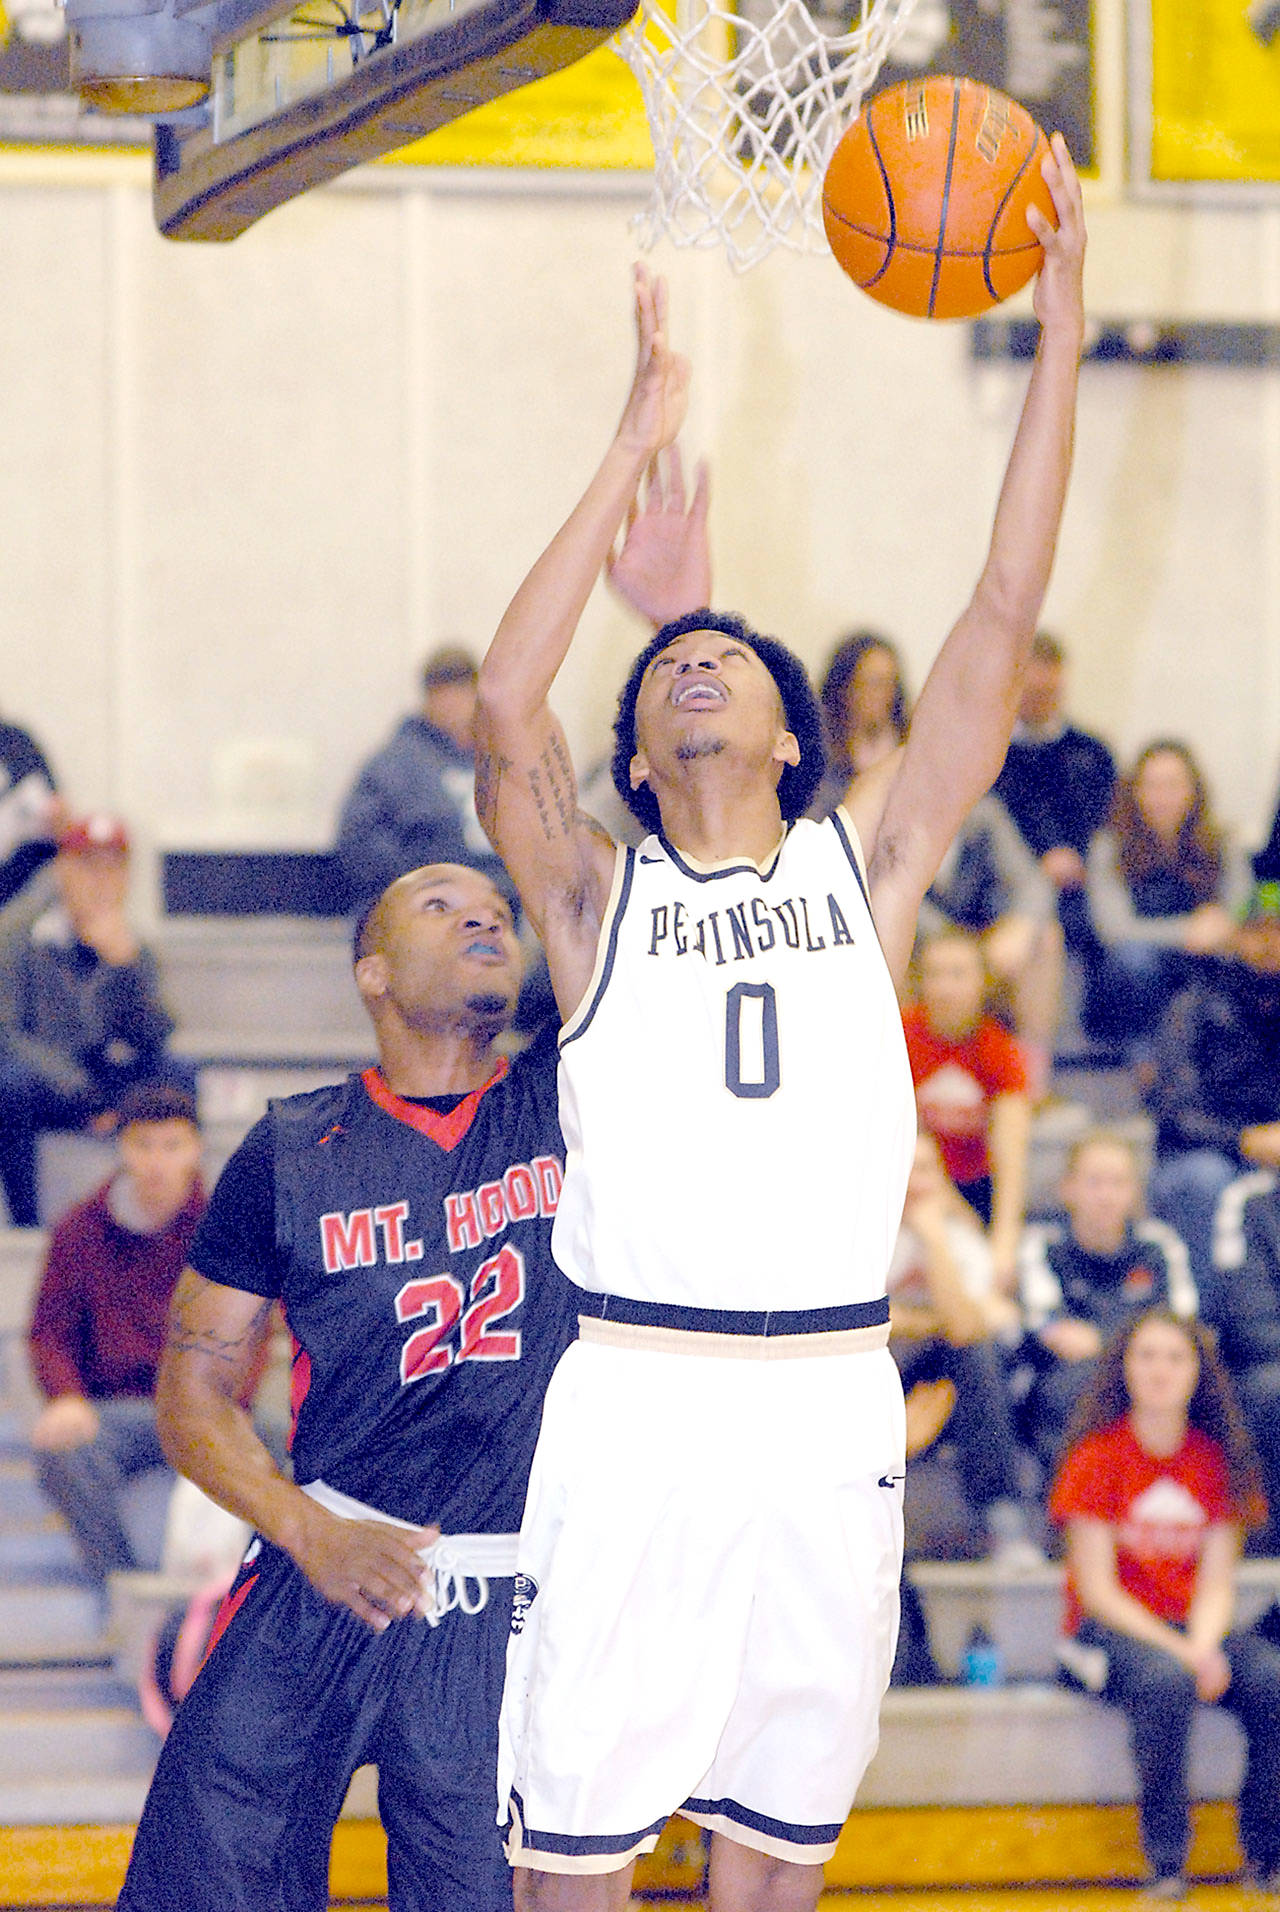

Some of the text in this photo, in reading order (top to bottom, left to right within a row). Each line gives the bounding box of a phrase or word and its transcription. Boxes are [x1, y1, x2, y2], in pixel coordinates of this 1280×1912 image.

[725, 981, 781, 1099] 0
[319, 1155, 565, 1273] MT. HOOD
[394, 1242, 525, 1386] 22
